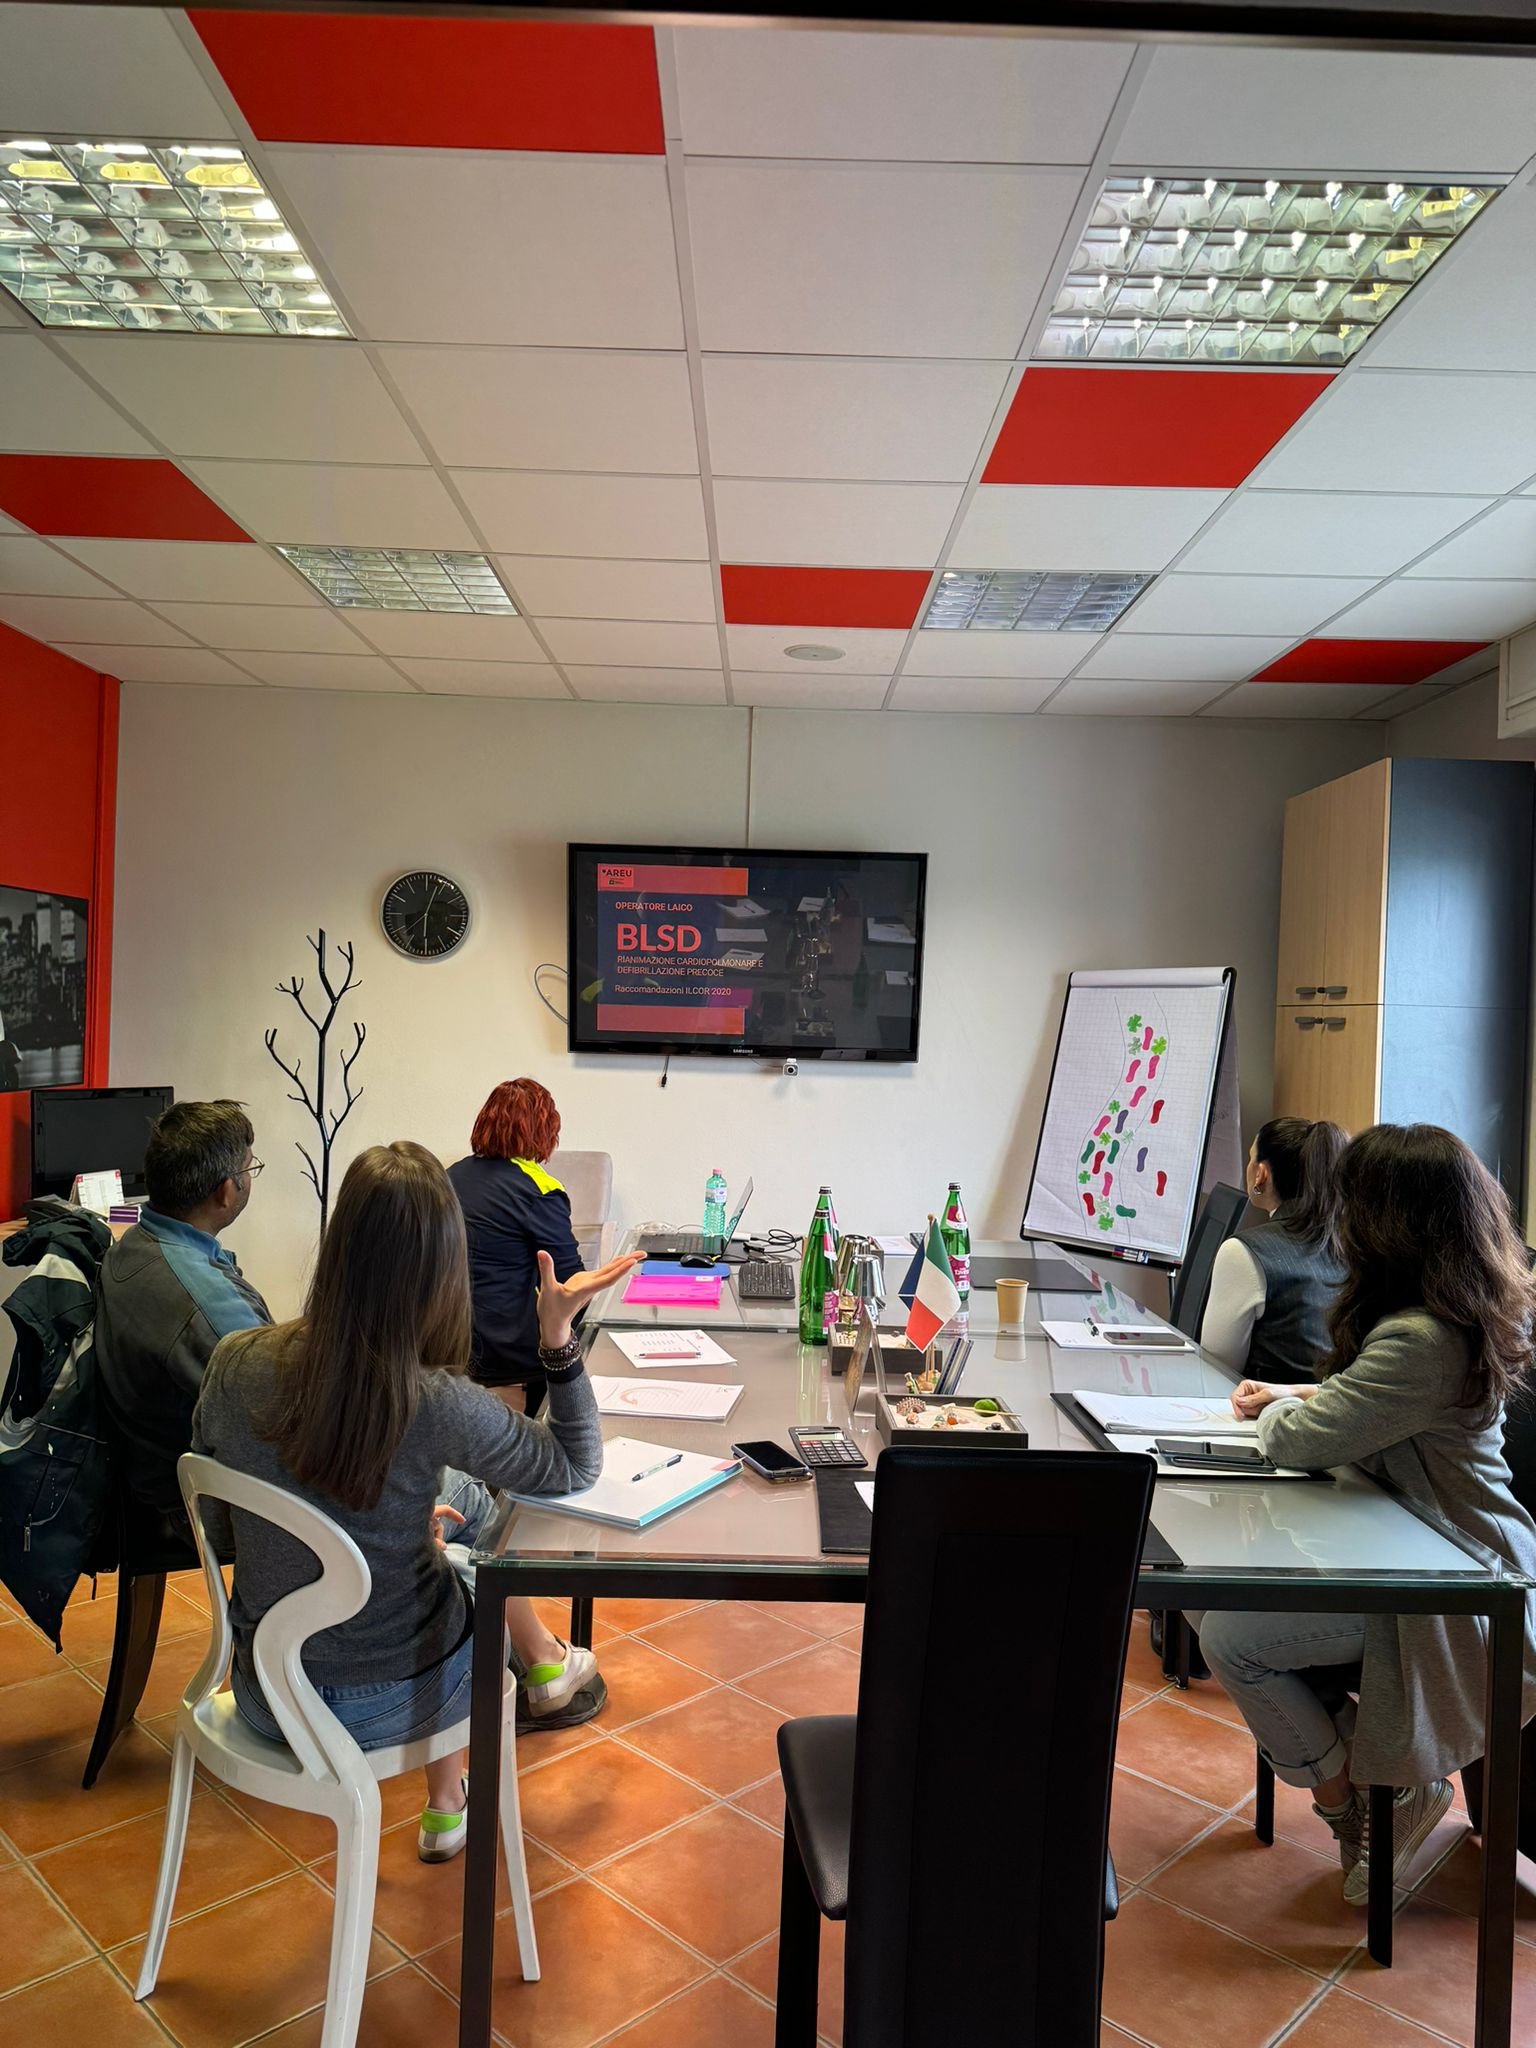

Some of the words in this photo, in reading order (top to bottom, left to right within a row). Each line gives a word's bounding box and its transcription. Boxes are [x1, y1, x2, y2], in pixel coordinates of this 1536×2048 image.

[606, 869, 632, 877] AREU
[615, 902, 666, 911] OPERATORE
[667, 904, 693, 912] LAICO
[617, 924, 702, 952] BLSD
[617, 956, 675, 965] RIANIMAZIONE
[676, 957, 757, 967] CARDIOPOLMONARE
[618, 966, 686, 976] DEFIBRILLAZIONE
[687, 968, 724, 977] PRECOCE
[614, 985, 684, 994] Raccomandazioni
[685, 986, 710, 995] ILCOR
[711, 987, 732, 996] 2020
